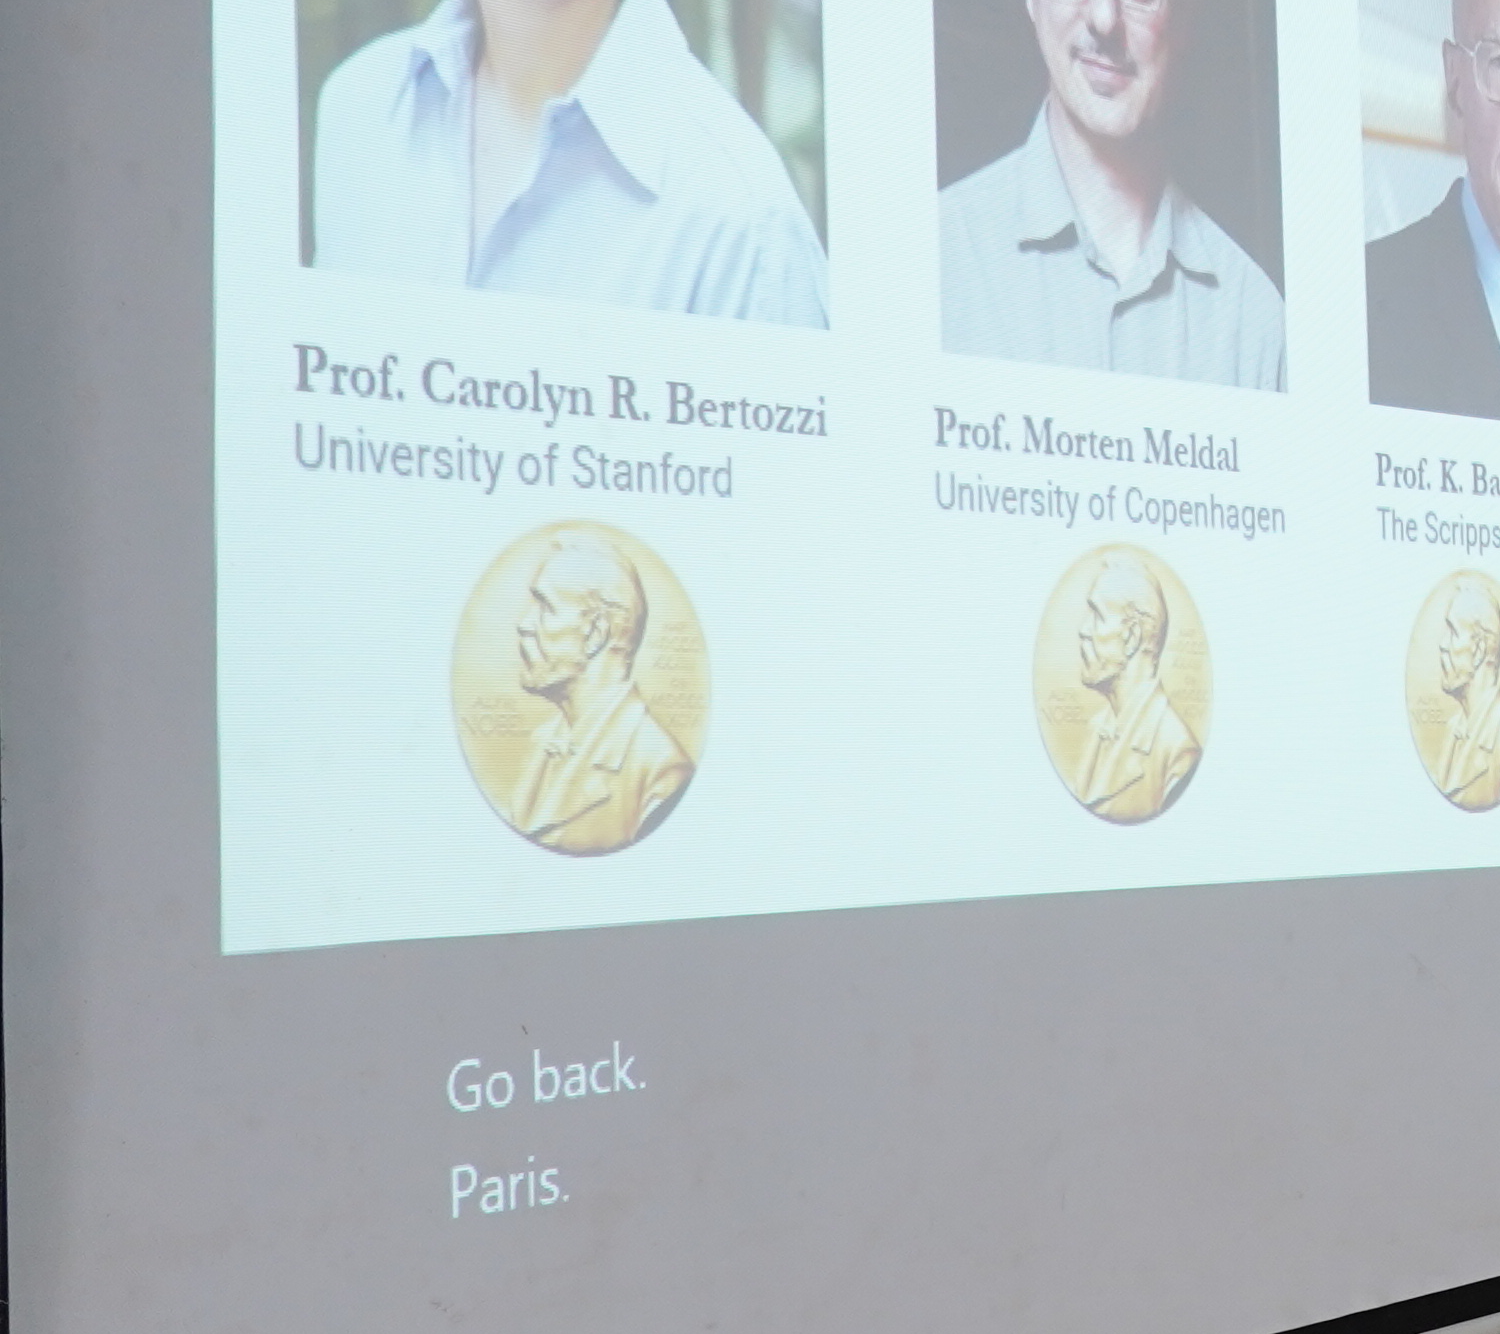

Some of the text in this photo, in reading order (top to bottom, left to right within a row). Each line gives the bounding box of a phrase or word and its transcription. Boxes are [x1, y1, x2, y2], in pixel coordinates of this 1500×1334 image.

[293, 343, 828, 436] Prof. Carolyn R. Bertozzi
[295, 422, 733, 498] University of Stanford
[933, 405, 1241, 473] Prof. Morten Meldal
[1375, 452, 1431, 491] Prof.
[1439, 459, 1463, 494] K.
[934, 470, 1286, 541] University of Copenhagen
[1376, 506, 1418, 543] The
[446, 1040, 646, 1113] Go back.
[452, 1155, 570, 1218] Paris.
